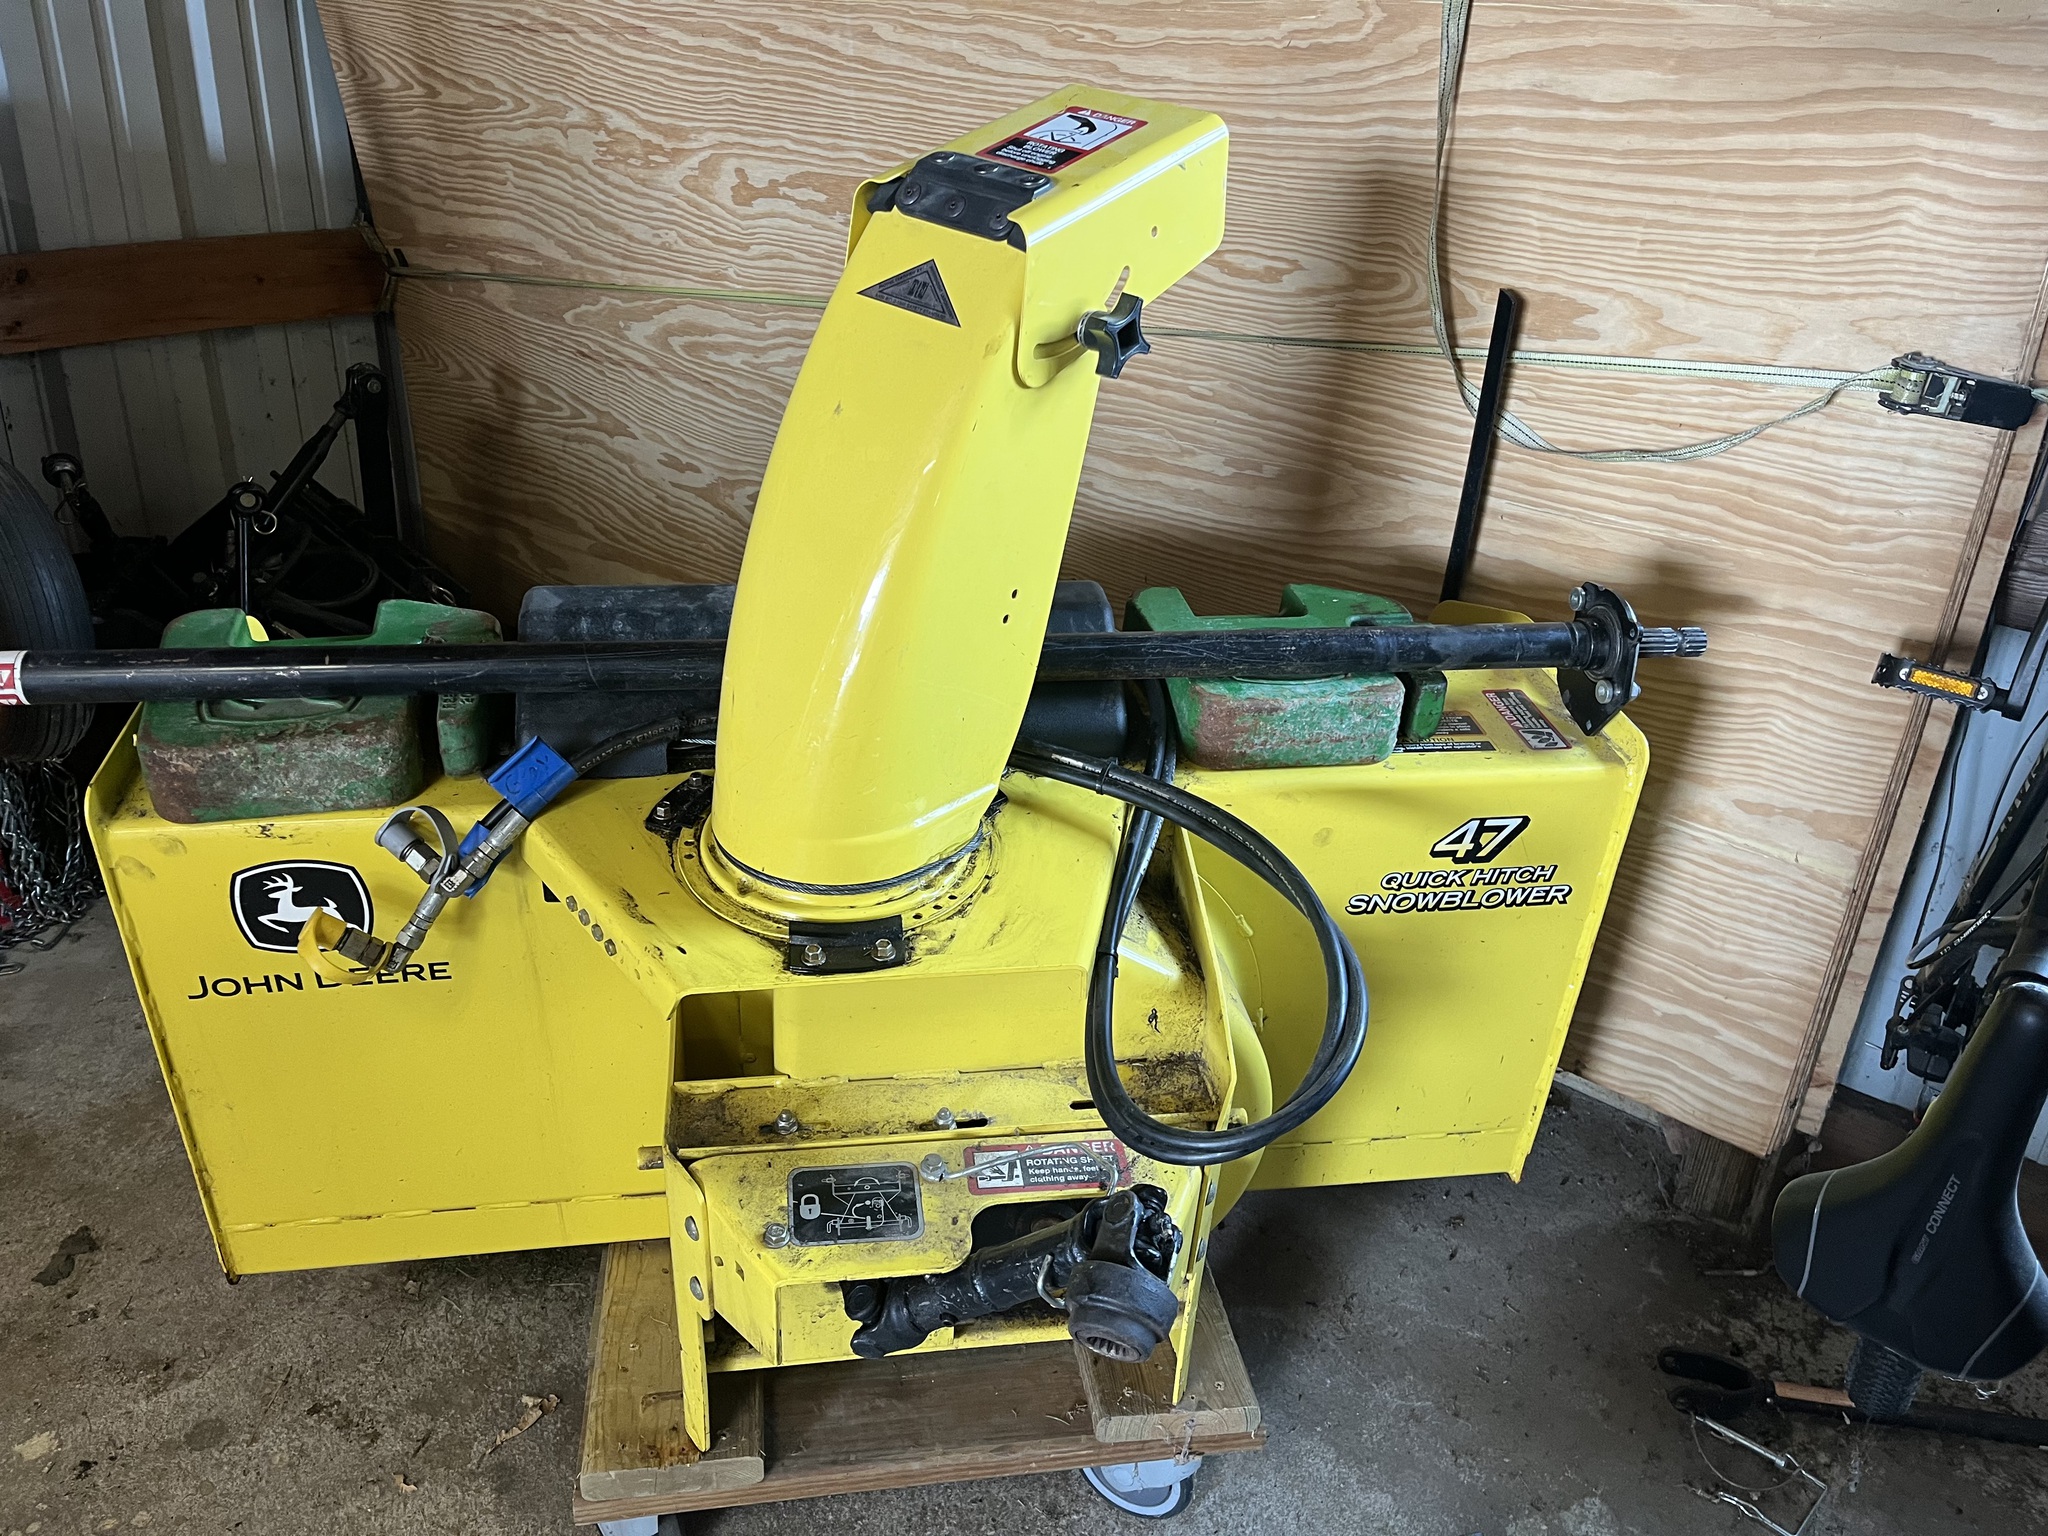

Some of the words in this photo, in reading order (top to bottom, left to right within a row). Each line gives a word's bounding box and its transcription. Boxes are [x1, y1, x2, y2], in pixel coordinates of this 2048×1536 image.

[1092, 112, 1136, 126] DANGER
[1486, 692, 1517, 721] DANGER
[1430, 816, 1531, 864] 47
[1381, 869, 1473, 891] QUICK
[1470, 865, 1558, 887] HITCH
[1345, 885, 1572, 915] SNOWBLOWER
[188, 973, 304, 1000] JOHN
[1026, 1156, 1078, 1166] ROTATING
[1081, 1154, 1114, 1164] SHFT
[1042, 1141, 1116, 1156] ANER
[1028, 1167, 1050, 1175] Keep
[1030, 1173, 1065, 1183] clothing
[1925, 1173, 1961, 1235] CONNECT
